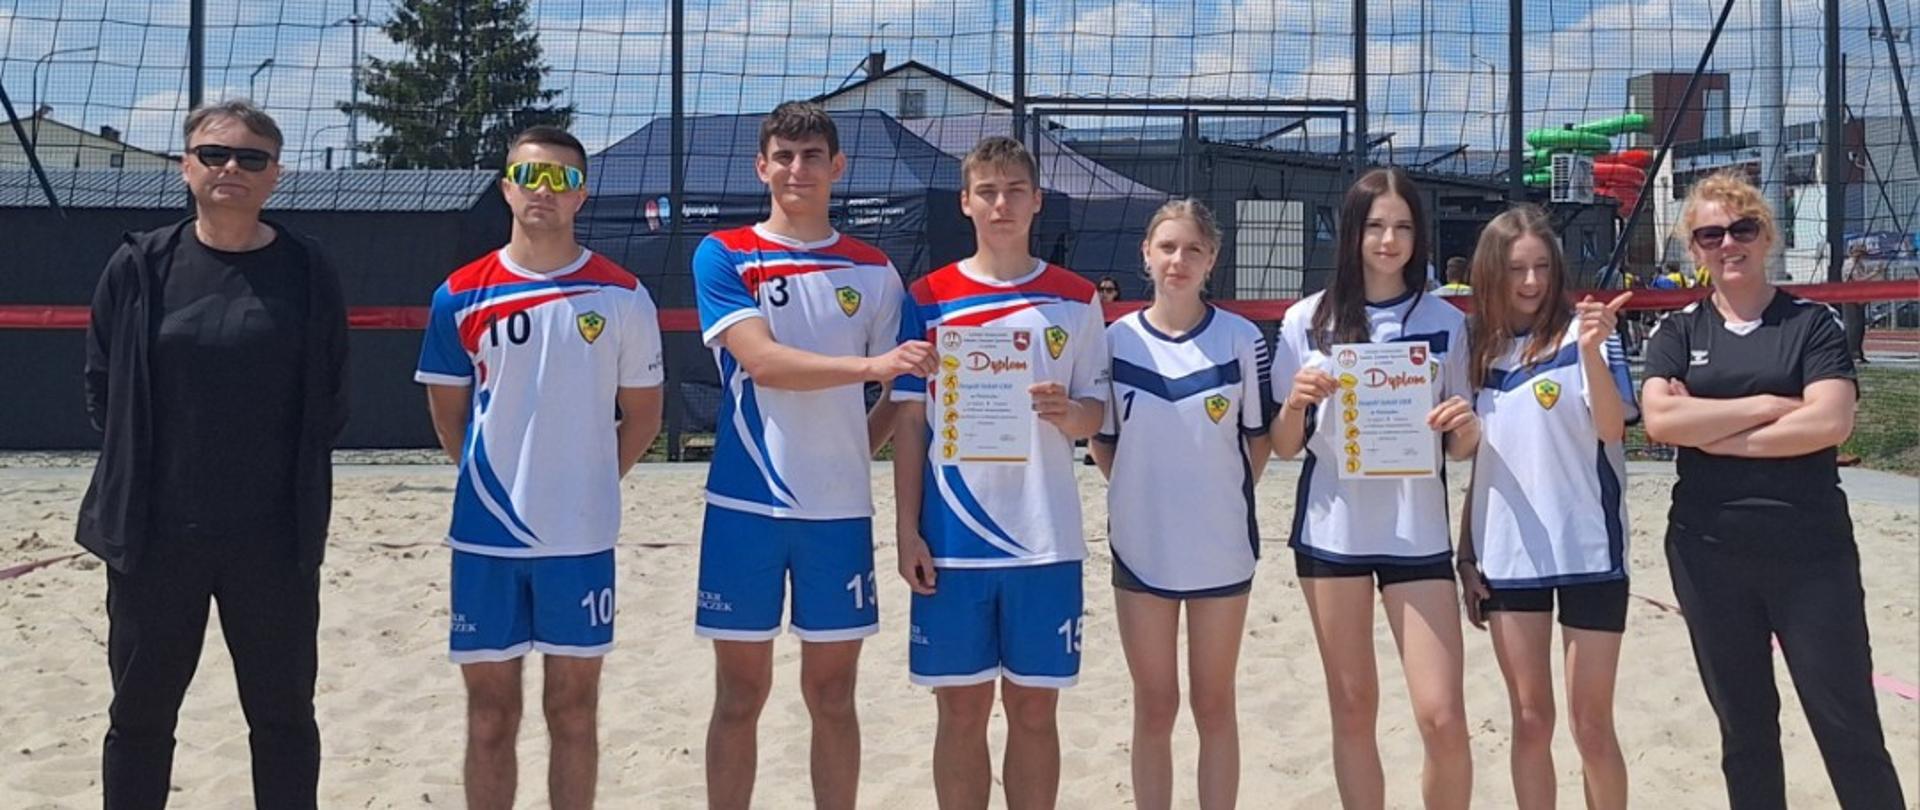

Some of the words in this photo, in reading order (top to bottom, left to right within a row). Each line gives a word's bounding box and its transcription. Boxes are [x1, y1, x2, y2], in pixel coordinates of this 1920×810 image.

[488, 309, 531, 347] 10
[966, 351, 1027, 374] Dyplom
[1363, 367, 1426, 391] Dyplom
[1123, 390, 1136, 422] 1
[581, 587, 613, 627] 10
[846, 571, 877, 609] 13
[1057, 615, 1083, 654] 15
